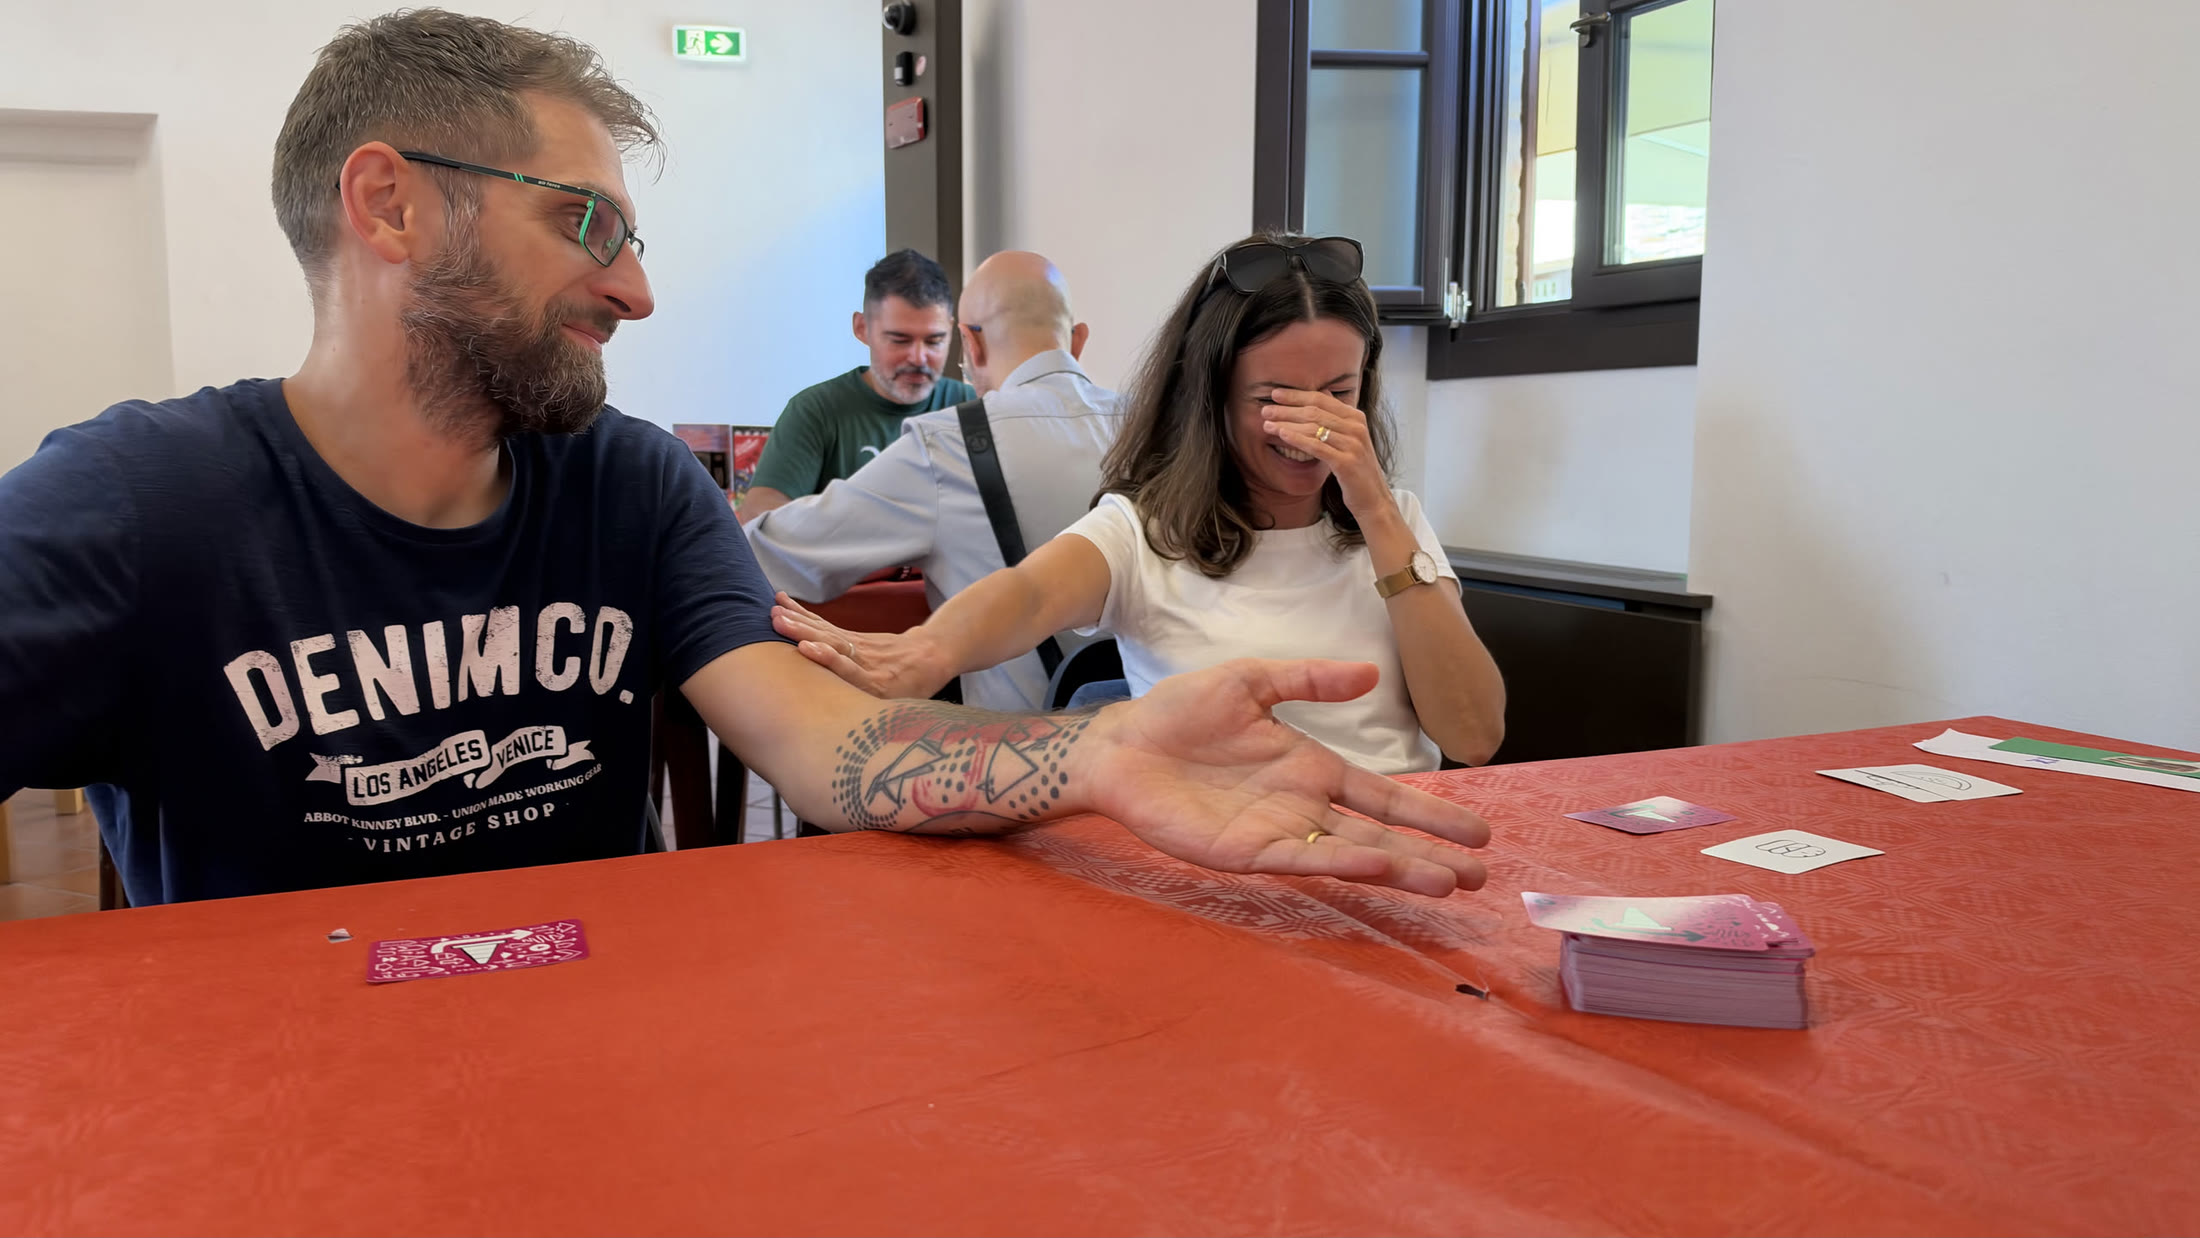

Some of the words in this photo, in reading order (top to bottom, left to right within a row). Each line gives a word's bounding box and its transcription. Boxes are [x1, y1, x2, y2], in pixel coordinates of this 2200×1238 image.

[223, 605, 520, 751] DENIM
[303, 812, 349, 825] ABBOT
[351, 818, 402, 831] KINNEY
[404, 813, 442, 828] BLVD.
[451, 799, 489, 819] UNION
[488, 790, 524, 807] MADE
[524, 775, 585, 798] WORKING
[584, 763, 602, 781] GEAR
[353, 772, 391, 799] LOS
[400, 739, 483, 790] ANGELES
[497, 729, 554, 769] VENICE
[362, 821, 477, 853] VINTAGE
[487, 802, 556, 829] SHOP
